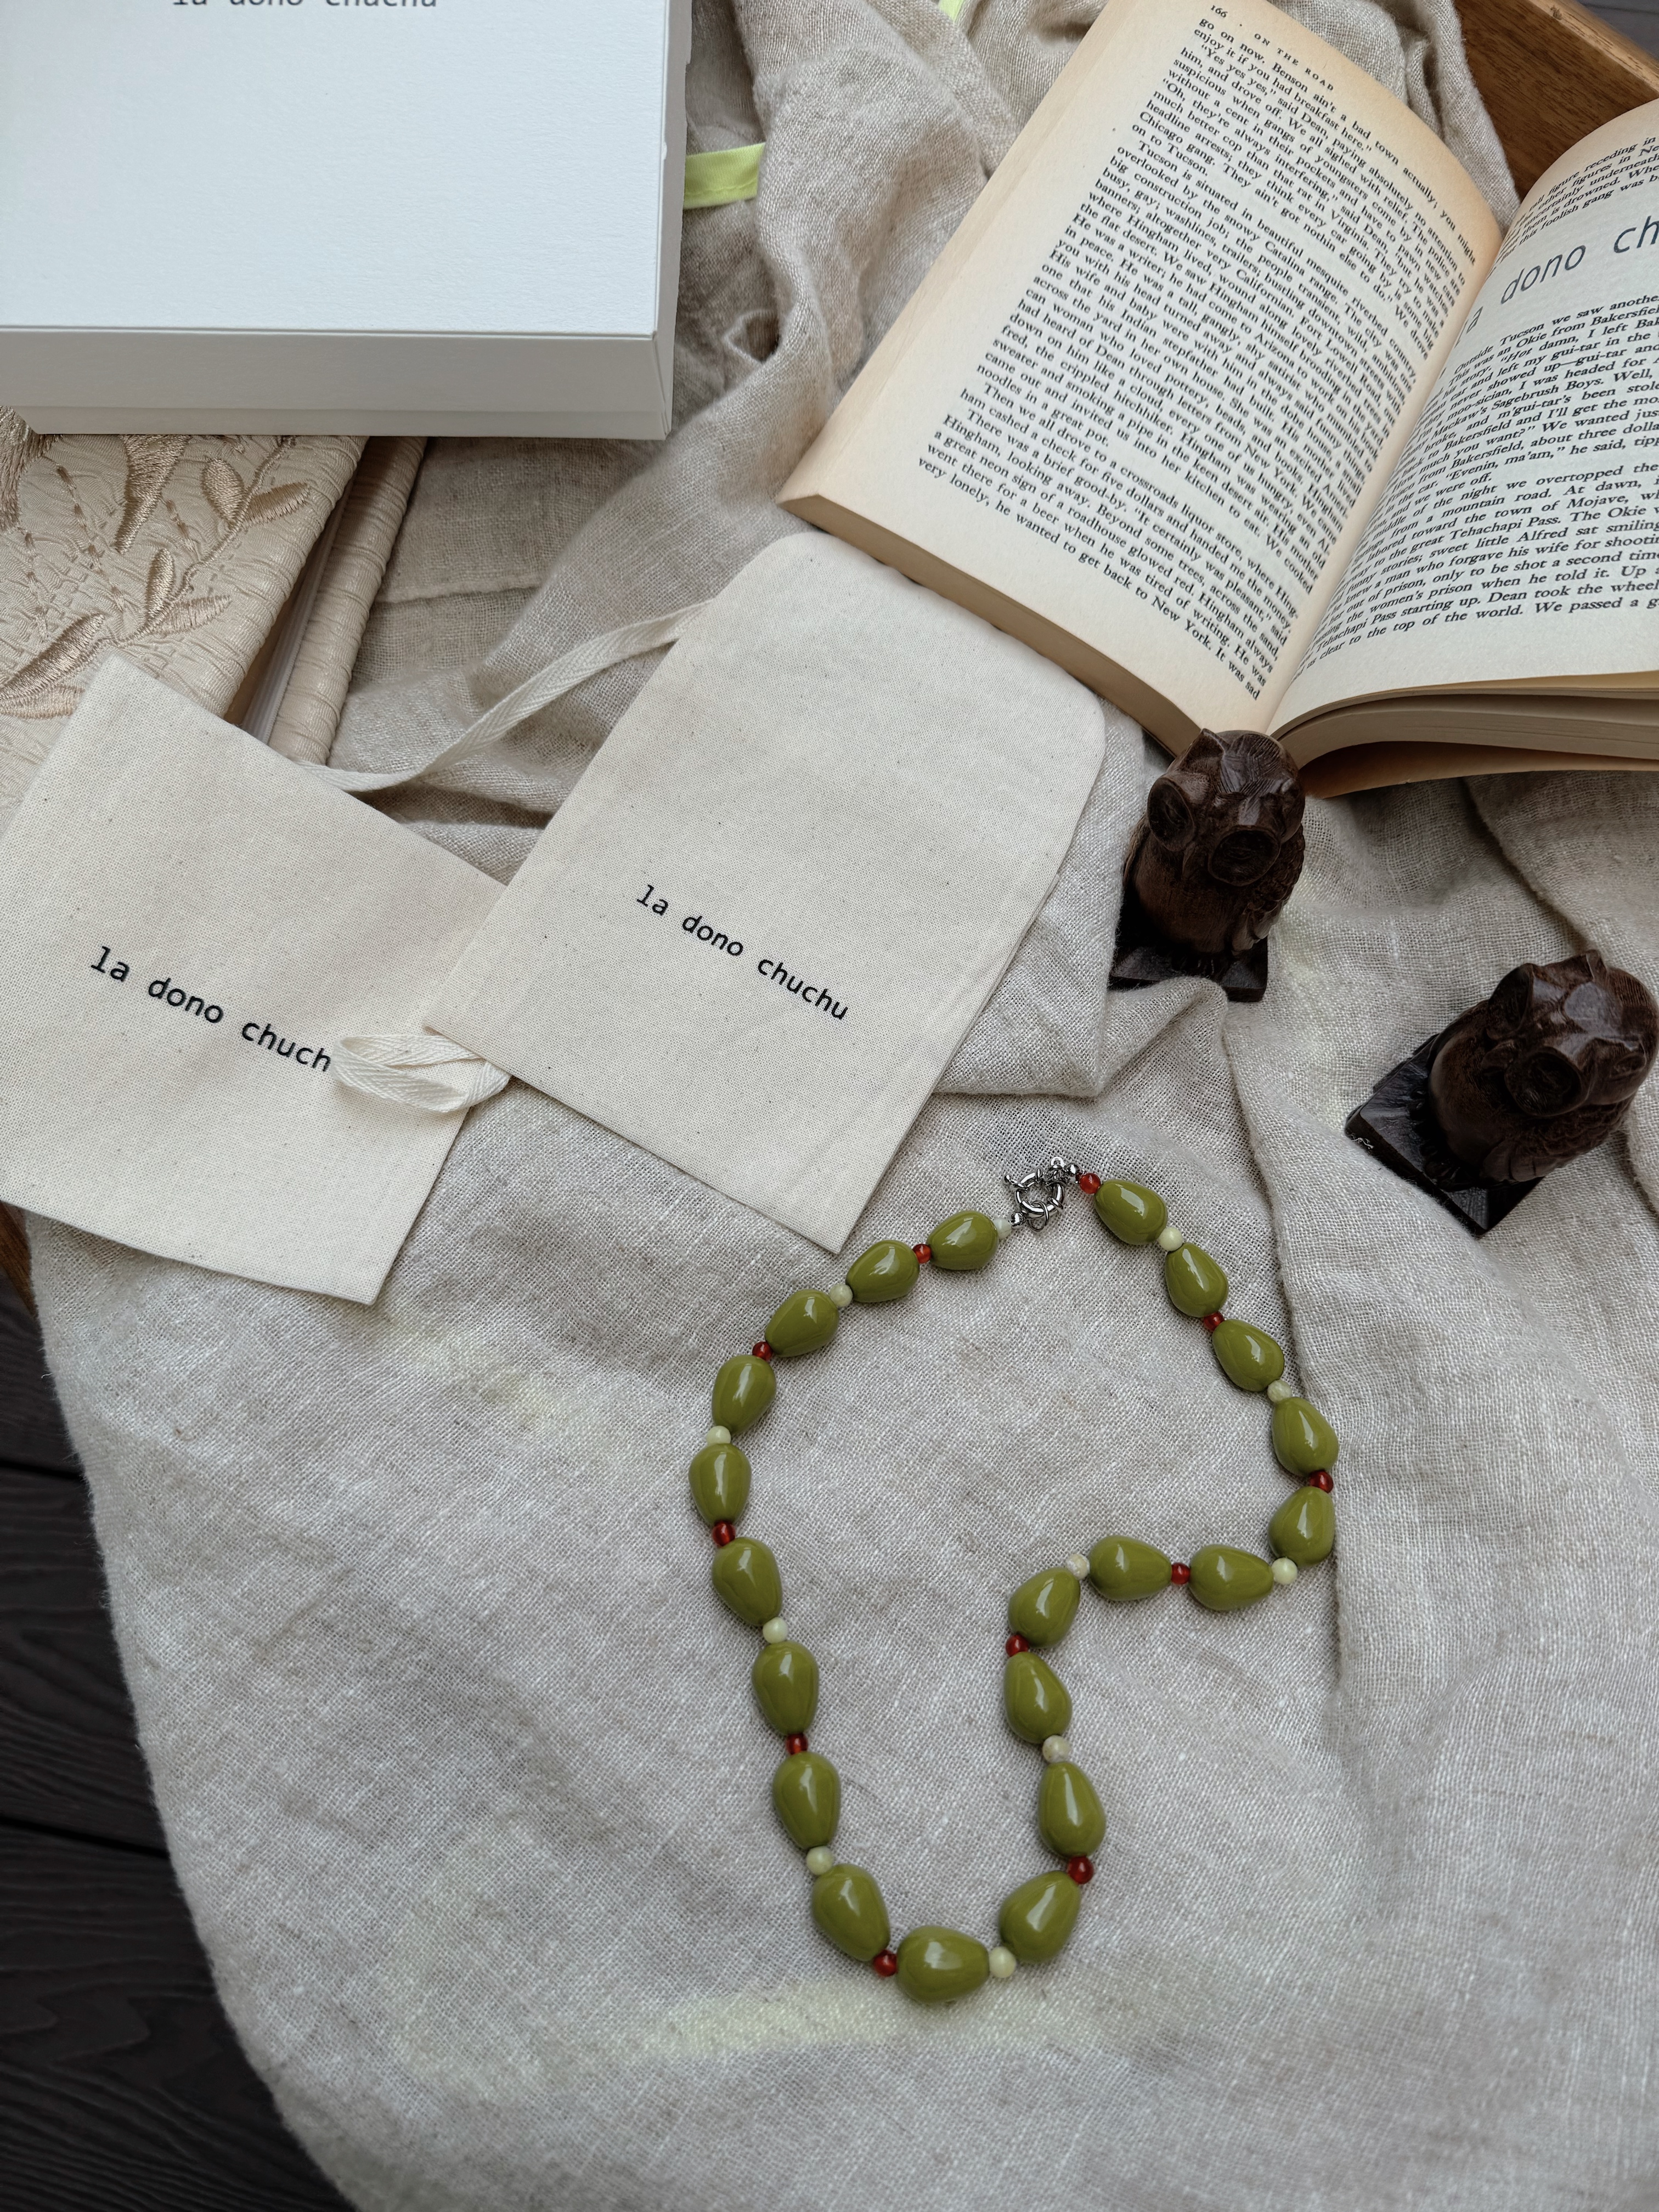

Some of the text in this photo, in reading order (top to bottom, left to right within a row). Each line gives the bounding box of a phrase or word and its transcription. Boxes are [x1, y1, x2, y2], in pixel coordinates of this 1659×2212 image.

[1210, 4, 1334, 91] 166 ON THE ROAD
[1172, 58, 1455, 307] suspicious when gangs of youngsters come by in new cars
[1198, 18, 1215, 30] go
[1220, 30, 1235, 44] on
[1239, 42, 1265, 64] now.
[1271, 61, 1308, 93] Benson
[1339, 113, 1347, 122] a
[1351, 120, 1372, 140] bad
[1374, 140, 1399, 166] town
[1439, 209, 1456, 232] you
[1457, 233, 1476, 266] might
[1548, 137, 1656, 195] figure receding in
[1138, 139, 1178, 173] Tucson
[1181, 168, 1193, 181] is
[1194, 179, 1239, 211] situated
[1240, 207, 1253, 222] in
[1256, 218, 1304, 258] beautiful
[1305, 257, 1349, 295] mesquite
[1351, 296, 1389, 337] riverbed
[1539, 205, 1579, 231] foolish
[1582, 189, 1615, 209] gang
[1620, 179, 1645, 192] was
[1550, 177, 1621, 216] is drowned.
[1094, 177, 1396, 426] banners; altogether very Californian. Fort Lowell Road, out
[1500, 245, 1587, 304] dono
[1449, 331, 1651, 402] car and left my gui-tar in the
[1453, 294, 1659, 375] Outside Tucson we saw anothe
[1025, 288, 1343, 533] can woman who loved pottery, beads, and books. Hingham
[1490, 383, 1560, 411] Sagebrush
[1564, 377, 1604, 391] Boys.
[1612, 367, 1654, 382] Well,
[1001, 324, 1327, 570] fred, the crippled hitchhiker. Hingham was wearing an old
[943, 413, 1279, 662] Hingham, looking away. Beyond some trees, across the sand,
[1345, 571, 1378, 595] funny
[1379, 554, 1424, 575] stories;
[1428, 541, 1470, 558] sweet
[1474, 534, 1510, 549] little
[1515, 526, 1569, 543] Alfred
[1575, 526, 1599, 536] sat
[1373, 504, 1647, 568] to the great Tehachapi Pass. The Okie
[918, 457, 1261, 701] very lonely, he wanted to get back to New York. It was sad
[1345, 598, 1365, 613] out
[1367, 588, 1384, 602] of
[1382, 578, 1426, 600] prison,
[1431, 568, 1465, 583] only
[1469, 567, 1485, 577] to
[1489, 562, 1509, 574] be
[1512, 558, 1548, 572] shot
[1550, 558, 1561, 567] a
[1565, 550, 1623, 566] second
[1318, 596, 1639, 660] clear to the top of the world. We passed a
[636, 884, 848, 1020] la dono chuchu
[91, 946, 331, 1072] la dono chuch
